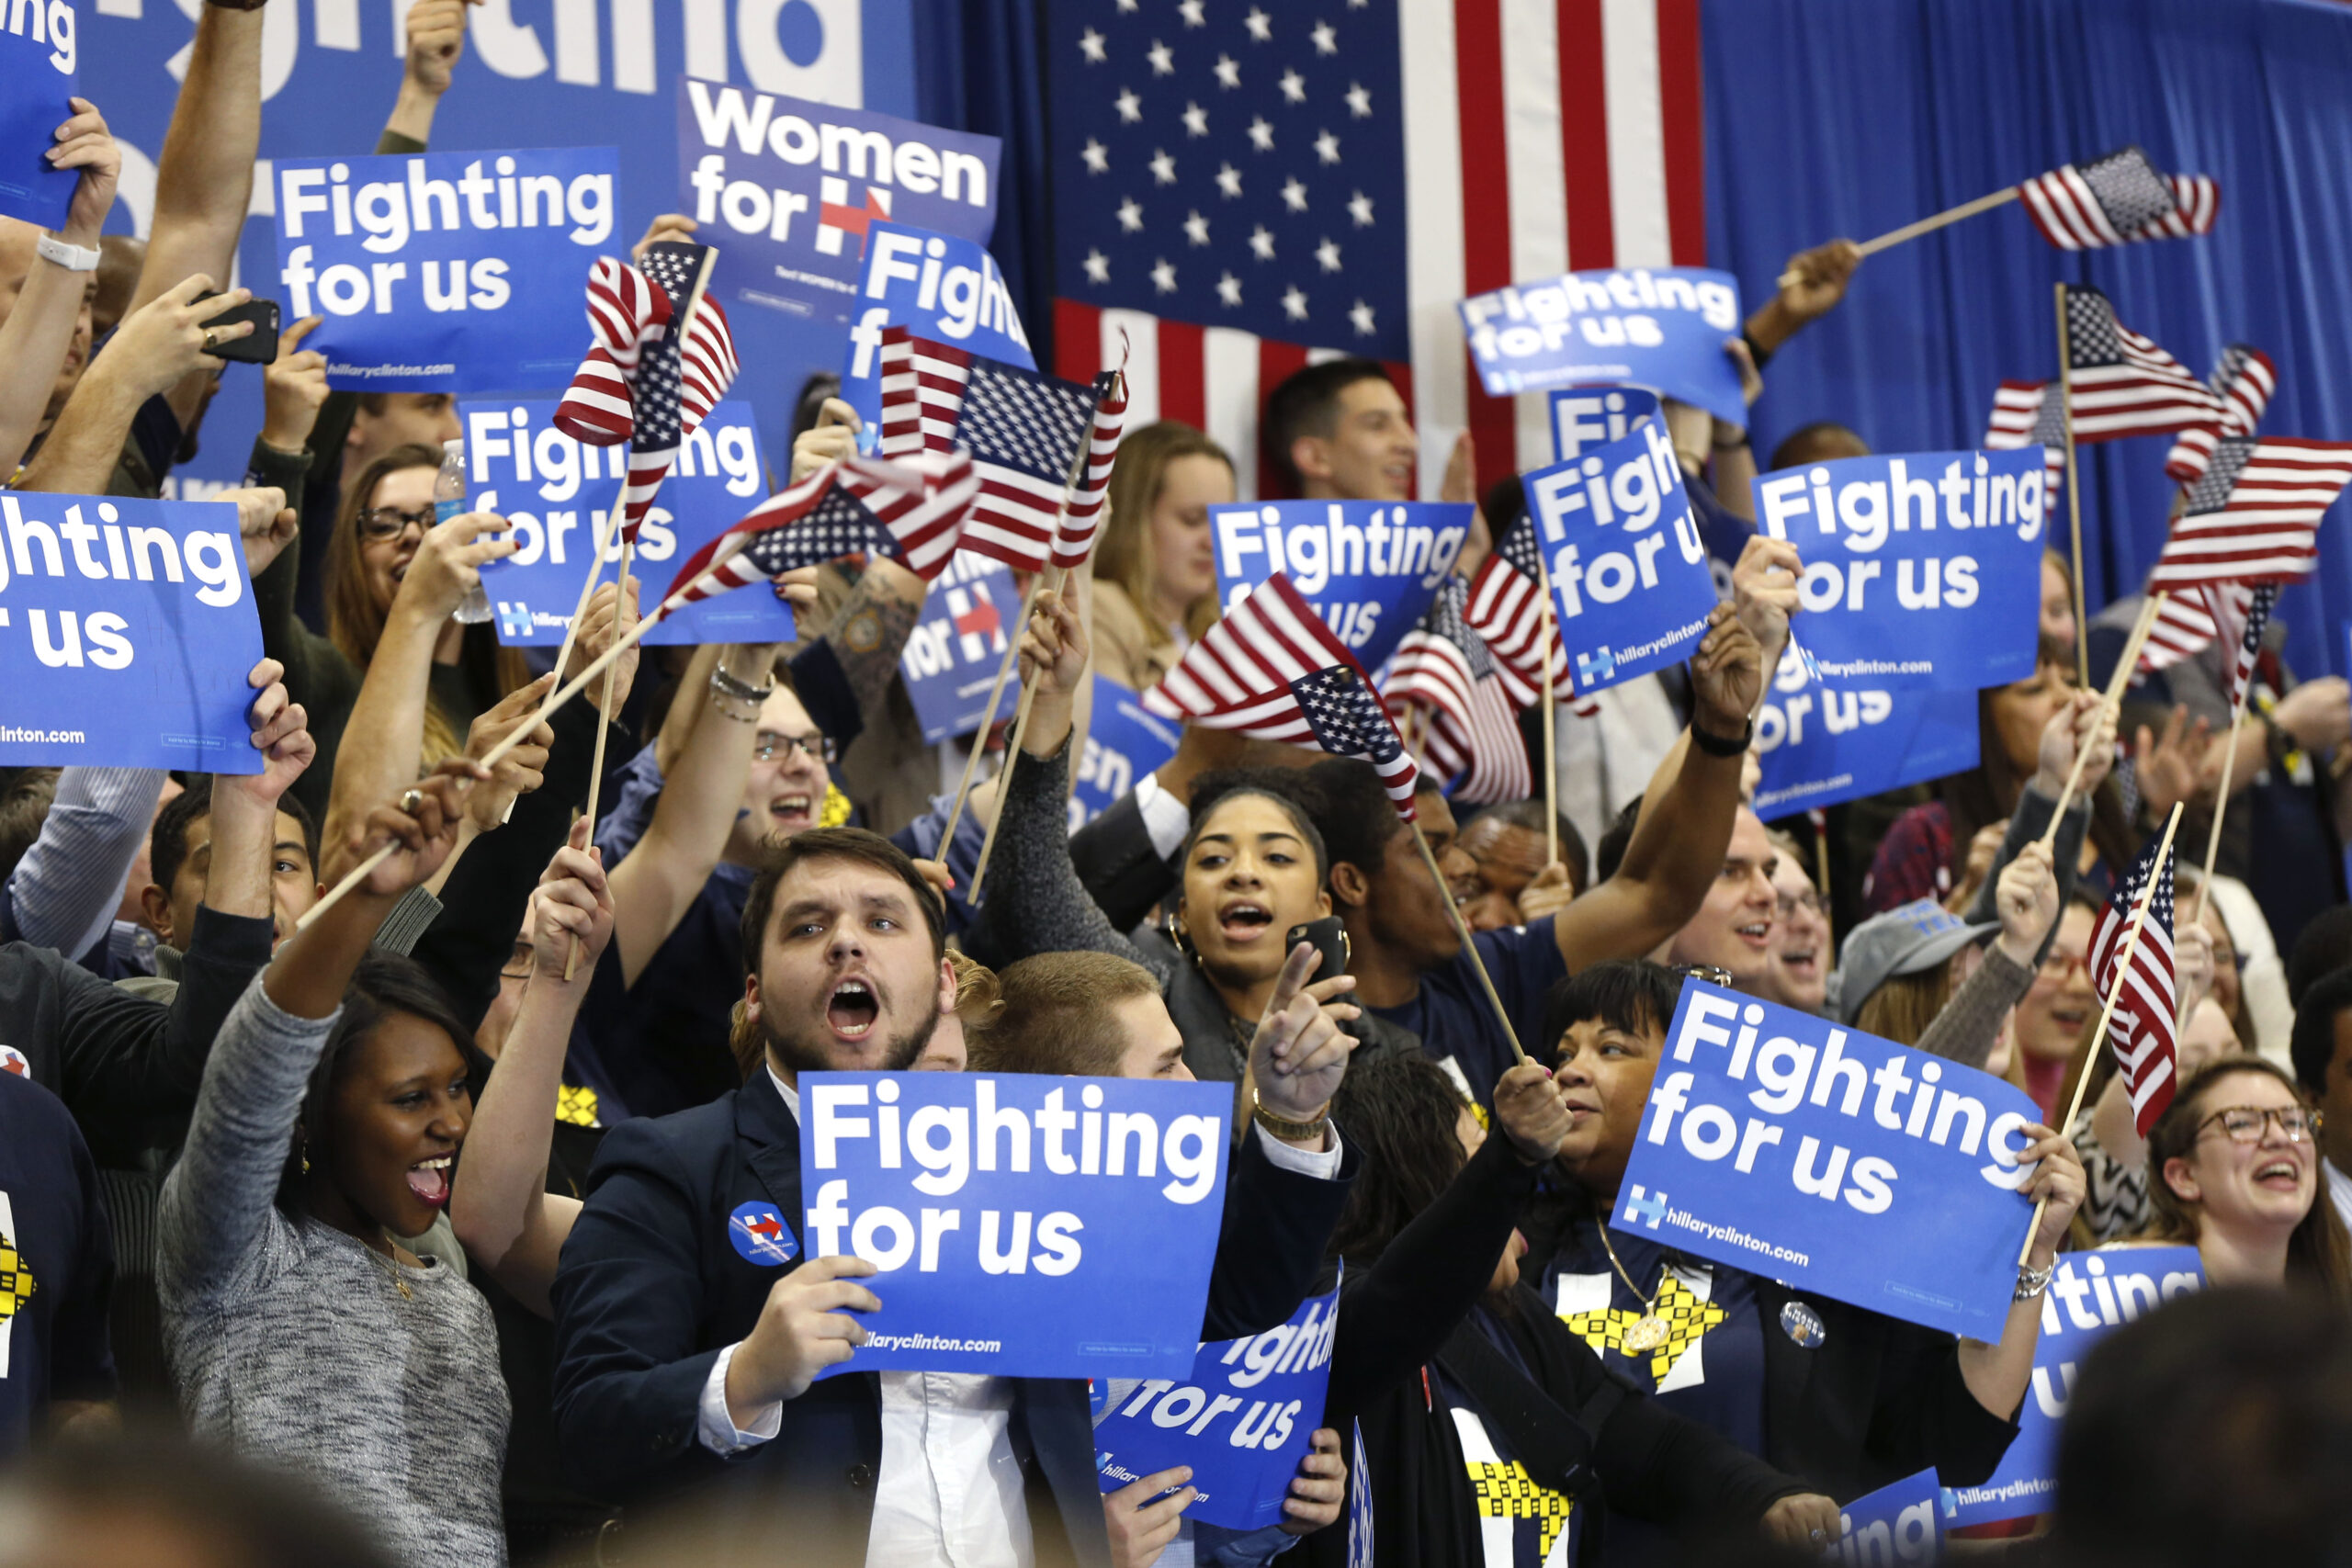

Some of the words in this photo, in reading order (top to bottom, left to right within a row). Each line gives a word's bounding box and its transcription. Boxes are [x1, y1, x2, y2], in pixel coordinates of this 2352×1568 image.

[687, 81, 988, 208] Women
[281, 155, 614, 254] Fighting
[691, 154, 808, 243] for
[281, 245, 406, 319] for
[422, 257, 511, 313] us
[1464, 269, 1737, 332] Fighting
[327, 363, 456, 379] hillaryclinton.com
[1472, 321, 1572, 362] for
[1578, 315, 1664, 348] us
[1556, 391, 1654, 462] Fi
[1761, 456, 2044, 553] Fighting
[1216, 503, 1466, 595] Fighting
[1550, 530, 1666, 618] for
[1767, 557, 1882, 613] or
[1896, 555, 1980, 610] us
[28, 608, 134, 671] us
[0, 725, 85, 744] inton.com
[1751, 694, 1814, 754] or
[1673, 989, 2039, 1190] Fighting
[810, 1078, 1221, 1205] Fighting
[1647, 1071, 1783, 1175] for
[1792, 1135, 1899, 1214] us
[807, 1179, 961, 1273] for
[978, 1209, 1085, 1277] us
[1666, 1209, 1810, 1268] hillaryclinton.com
[856, 1331, 1001, 1353] laryclinton.com
[1228, 1399, 1303, 1451] us
